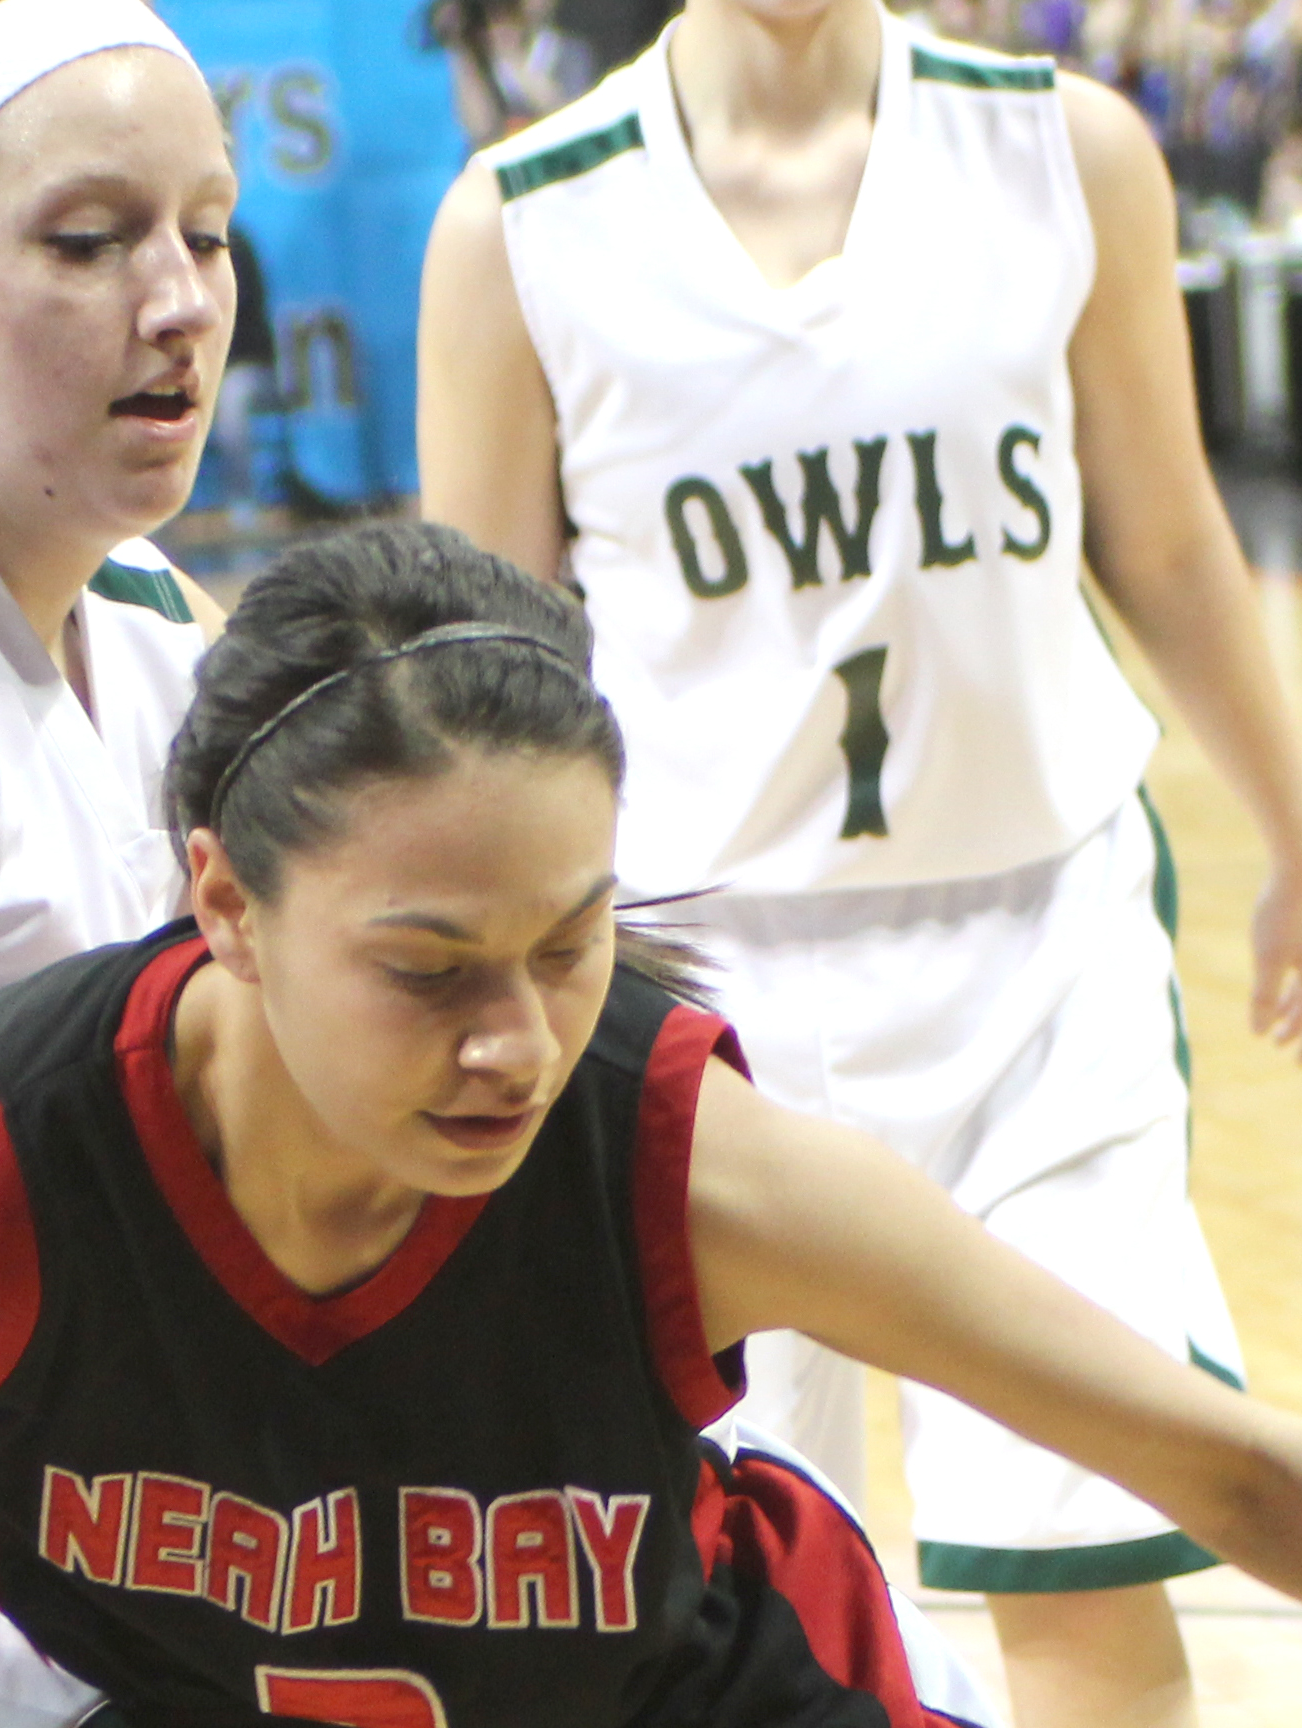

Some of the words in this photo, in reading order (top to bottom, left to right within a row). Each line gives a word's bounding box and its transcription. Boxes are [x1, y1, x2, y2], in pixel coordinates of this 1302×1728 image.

[663, 422, 1054, 600] OWLS
[832, 643, 890, 841] 1
[37, 1463, 363, 1637] NEAH
[398, 1484, 651, 1633] BAY
